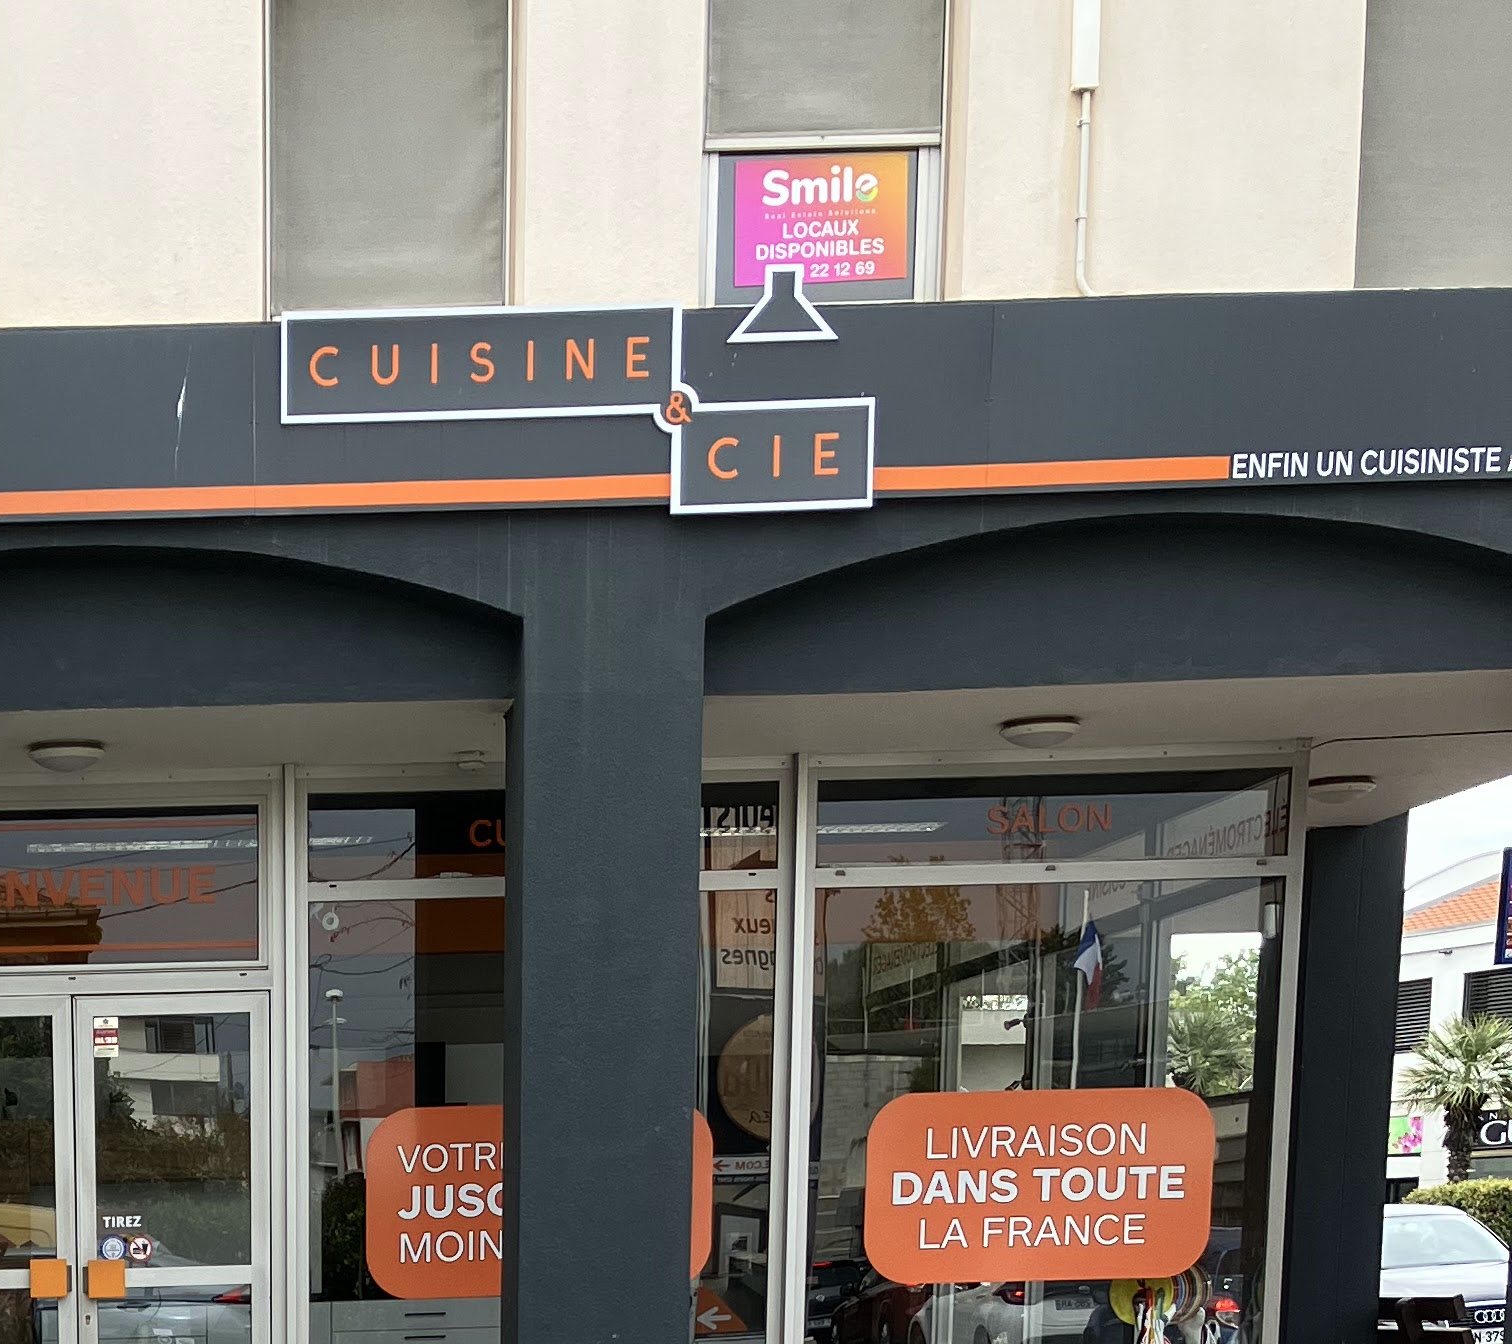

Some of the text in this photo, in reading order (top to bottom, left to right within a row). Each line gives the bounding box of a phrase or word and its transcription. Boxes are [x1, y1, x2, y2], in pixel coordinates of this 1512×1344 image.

[762, 165, 878, 206] Smile
[782, 219, 859, 239] LOCAUX
[755, 238, 885, 261] DISPONIBLES
[809, 260, 875, 278] 22 12 69
[309, 336, 650, 387] CUISINE
[665, 392, 691, 424] &
[707, 432, 839, 479] CIE
[1232, 451, 1308, 479] ENFIN
[1316, 450, 1353, 476] UN
[1360, 447, 1501, 476] CUISINISTE
[988, 803, 1112, 834] SALON
[926, 1122, 1147, 1160] LIVRAISON
[396, 1142, 503, 1173] VOTR
[891, 1165, 1186, 1205] DANS TOUTE
[102, 1215, 142, 1229] TIREZ
[919, 1213, 1146, 1249] LA FRANCE
